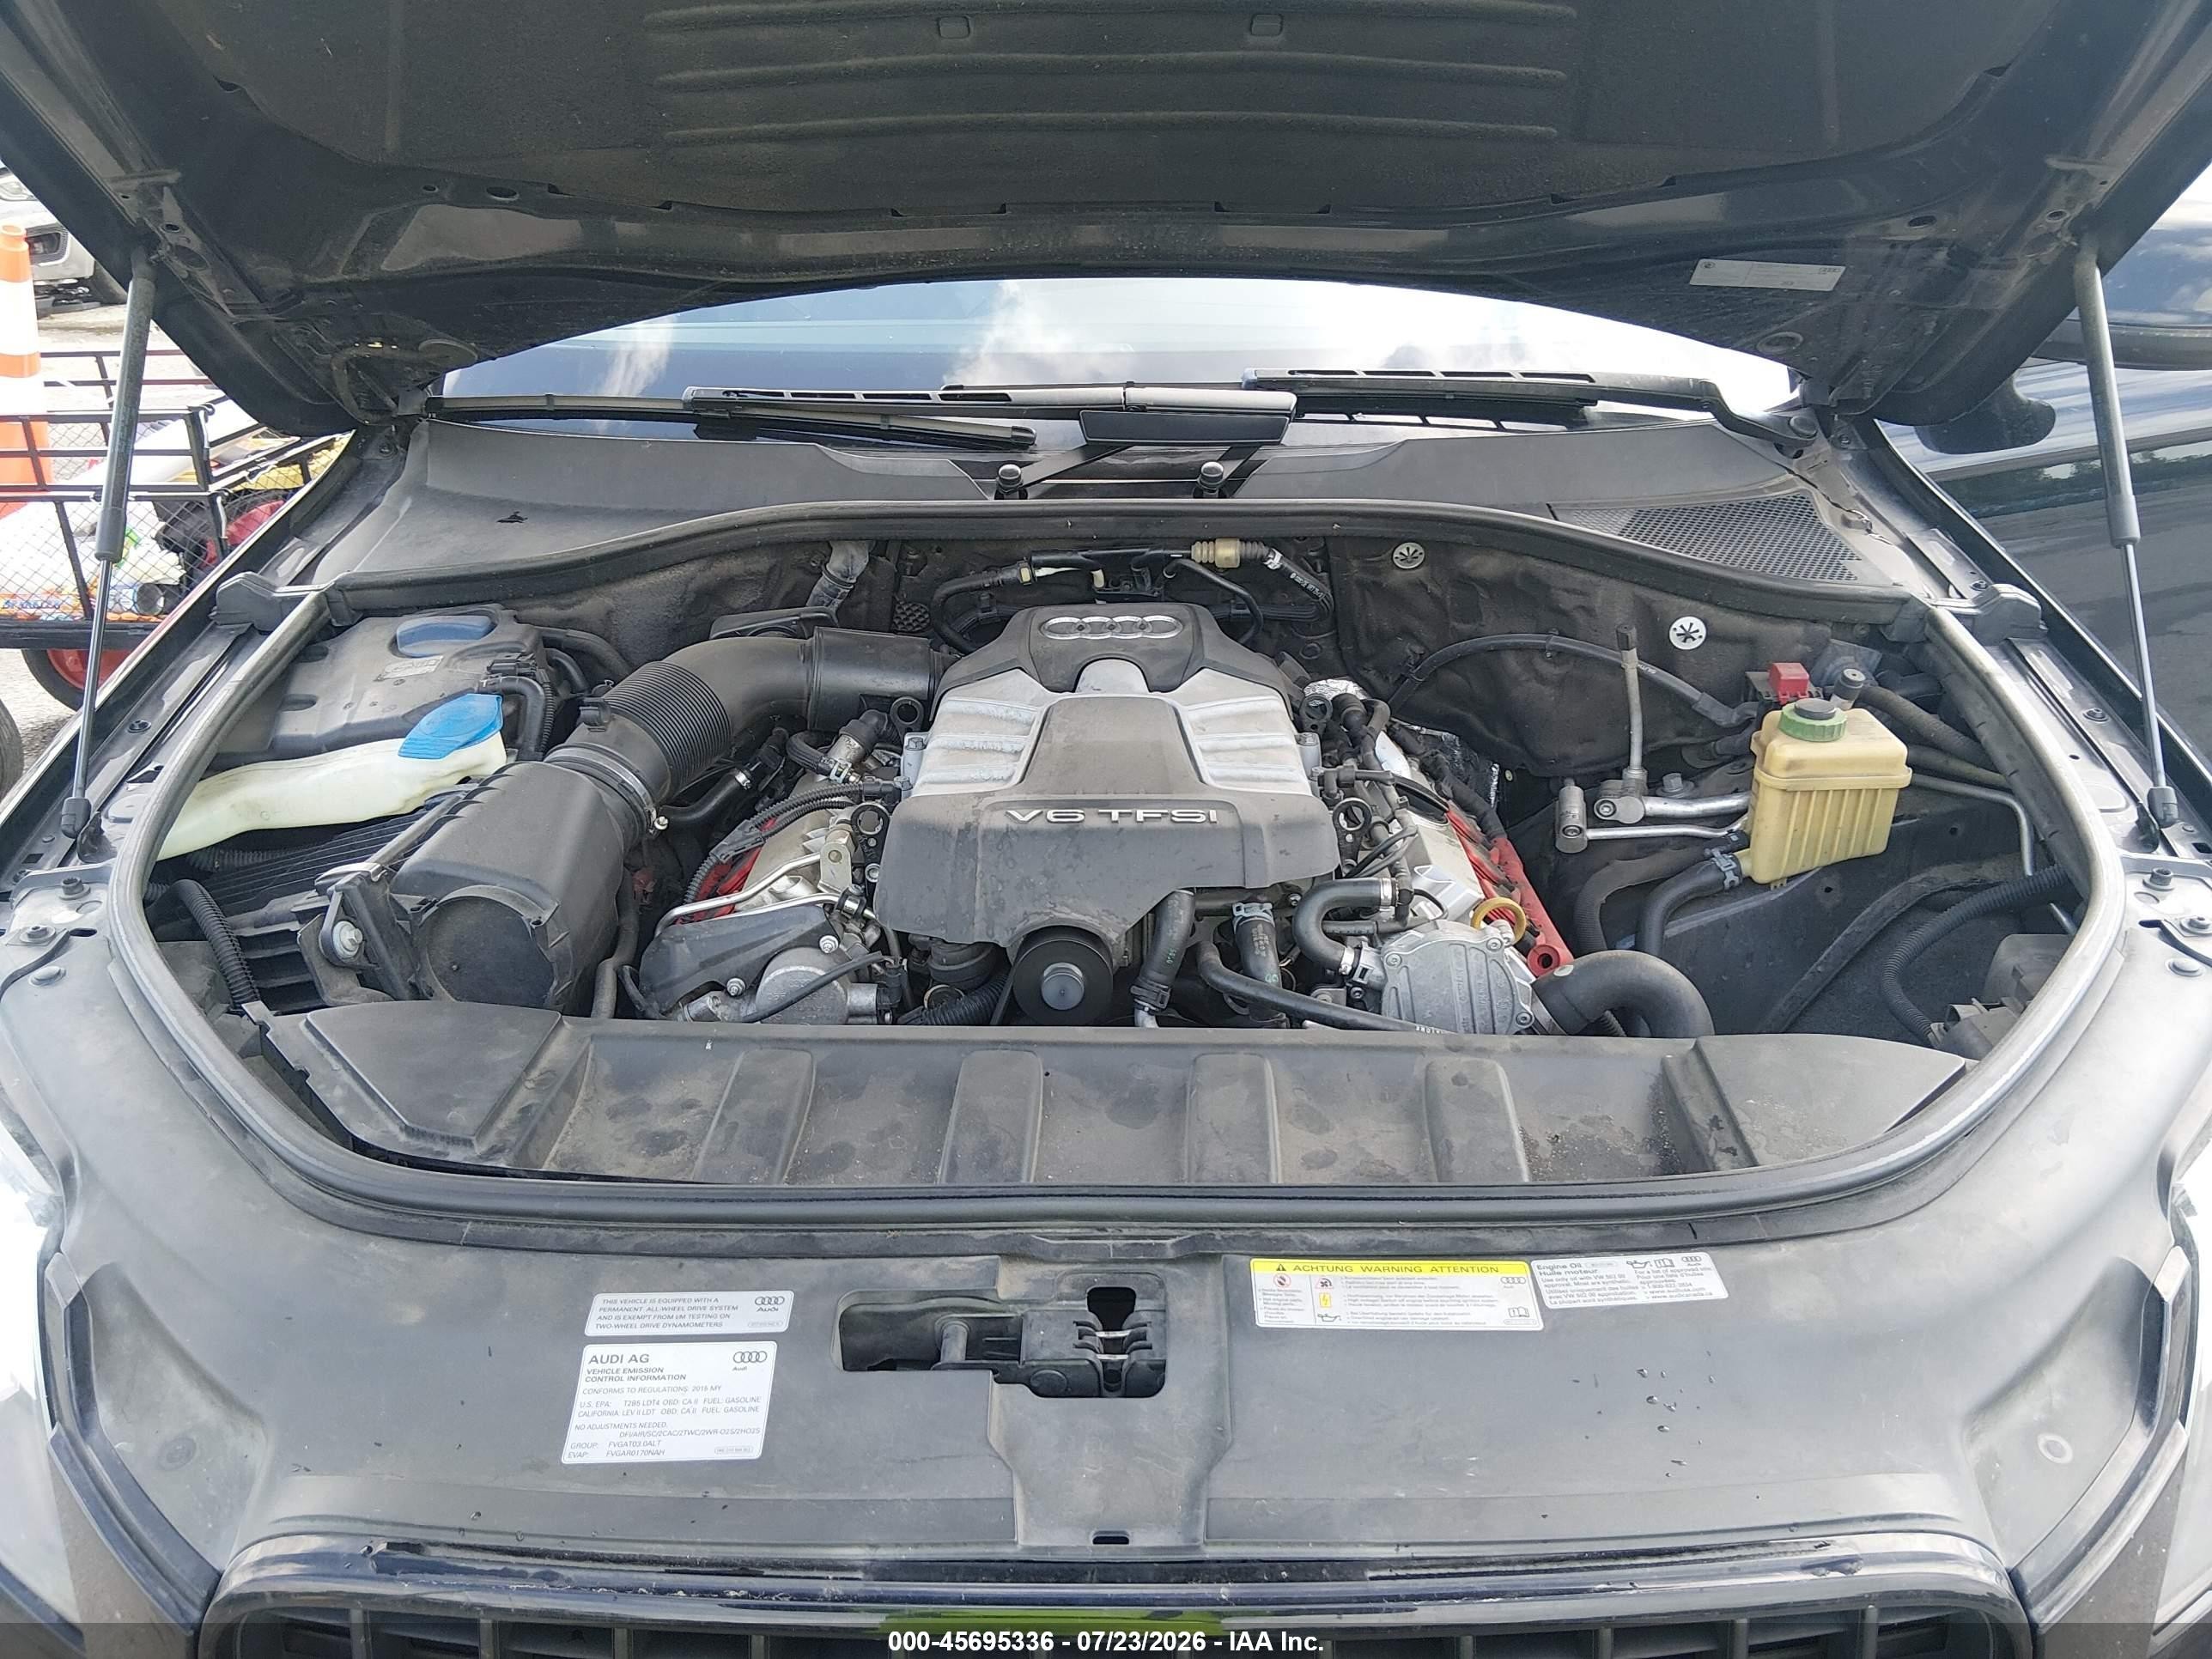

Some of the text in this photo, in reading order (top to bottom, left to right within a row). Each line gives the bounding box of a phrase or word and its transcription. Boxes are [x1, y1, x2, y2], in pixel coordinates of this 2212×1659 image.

[1005, 809, 1218, 824] V6 TFSI
[1536, 1263, 1567, 1272] Engine
[588, 1353, 650, 1364] AUDI AG
